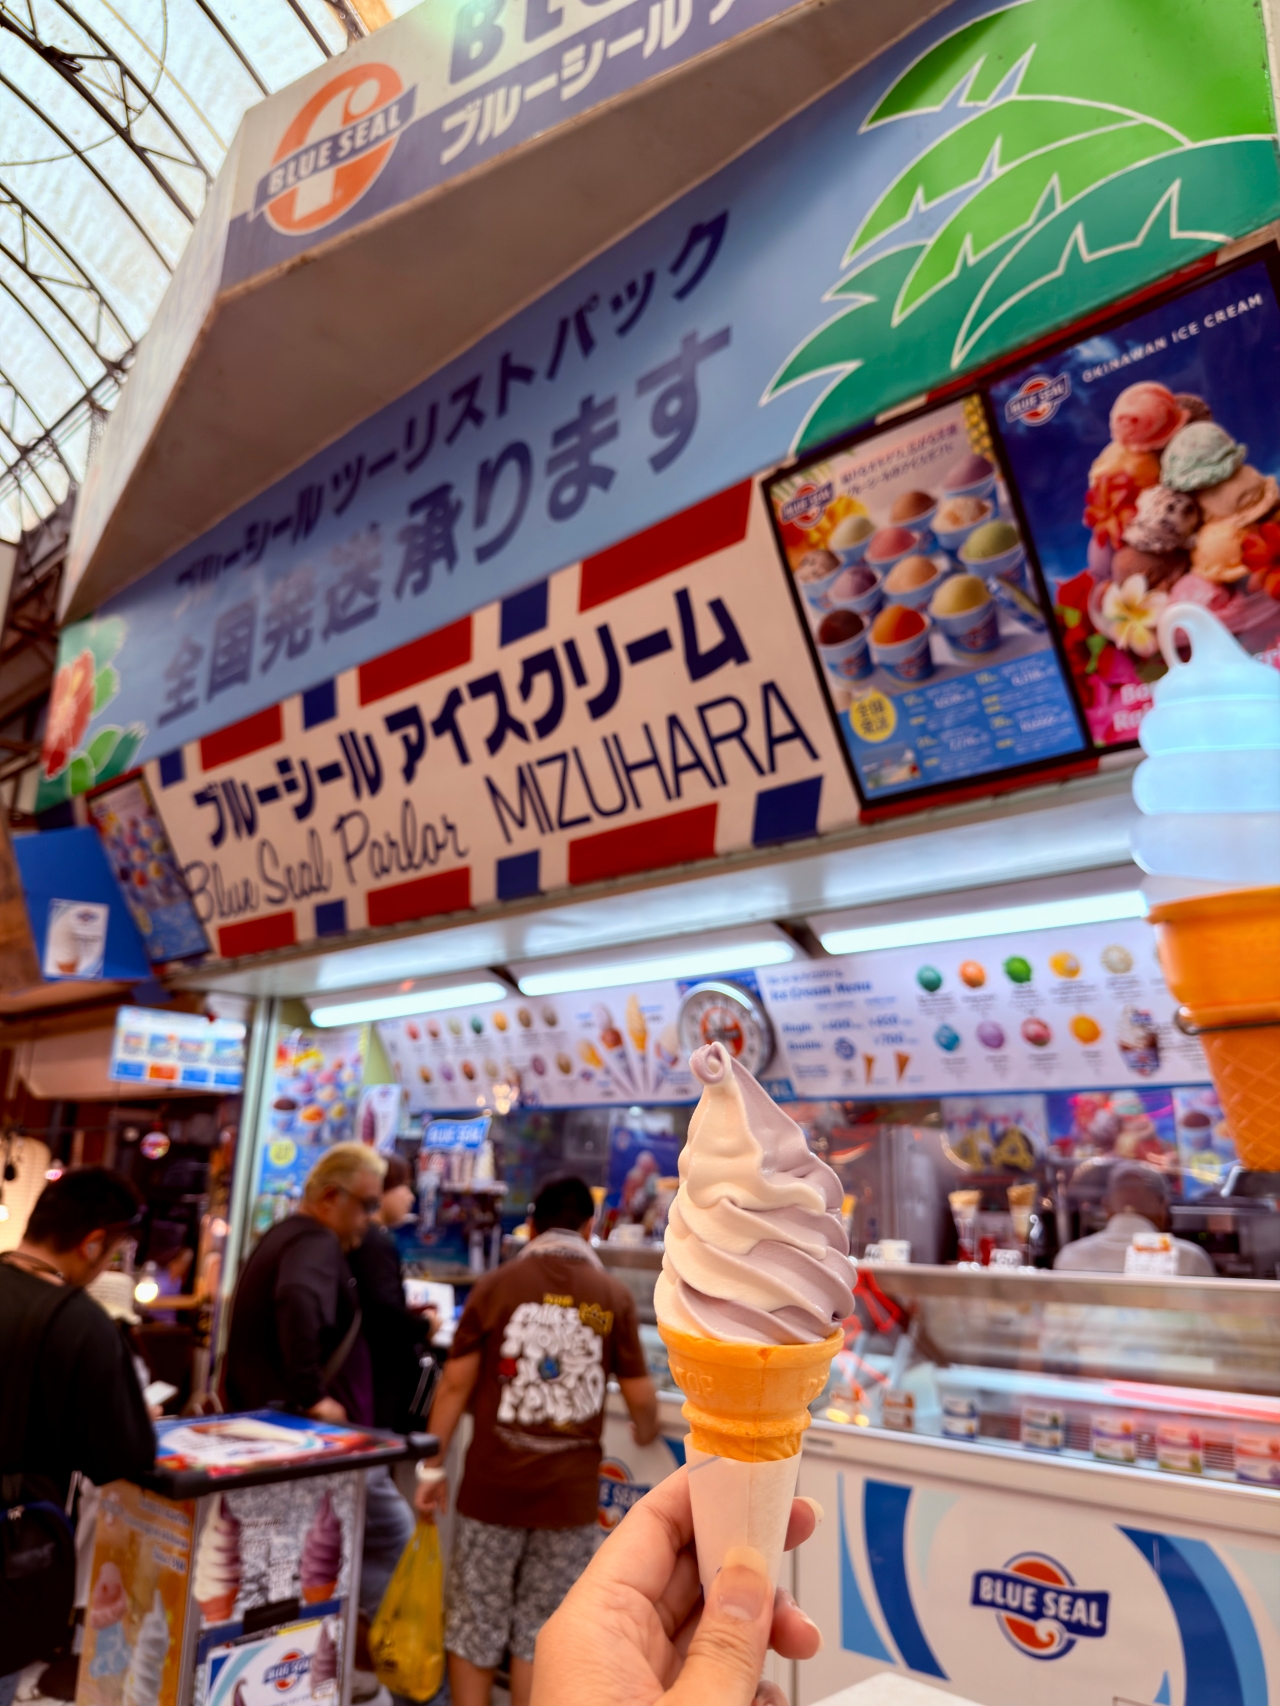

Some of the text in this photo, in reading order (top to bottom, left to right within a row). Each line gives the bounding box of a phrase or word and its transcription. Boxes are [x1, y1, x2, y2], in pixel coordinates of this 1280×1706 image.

[447, 0, 612, 86] BL
[268, 104, 401, 196] BLUE SEAL
[1082, 293, 1264, 383] OKINAWAN ICE CREAM
[1010, 394, 1037, 414] BLUE
[157, 324, 732, 728] 全国発送承ります
[193, 586, 751, 848] ブルーシールアイスクリーム
[184, 858, 259, 925] Blue
[257, 827, 332, 906] Seal
[333, 798, 470, 886] Parlor
[486, 680, 820, 844] MIZUHARA
[979, 1574, 1103, 1629] BLUE SEAL
